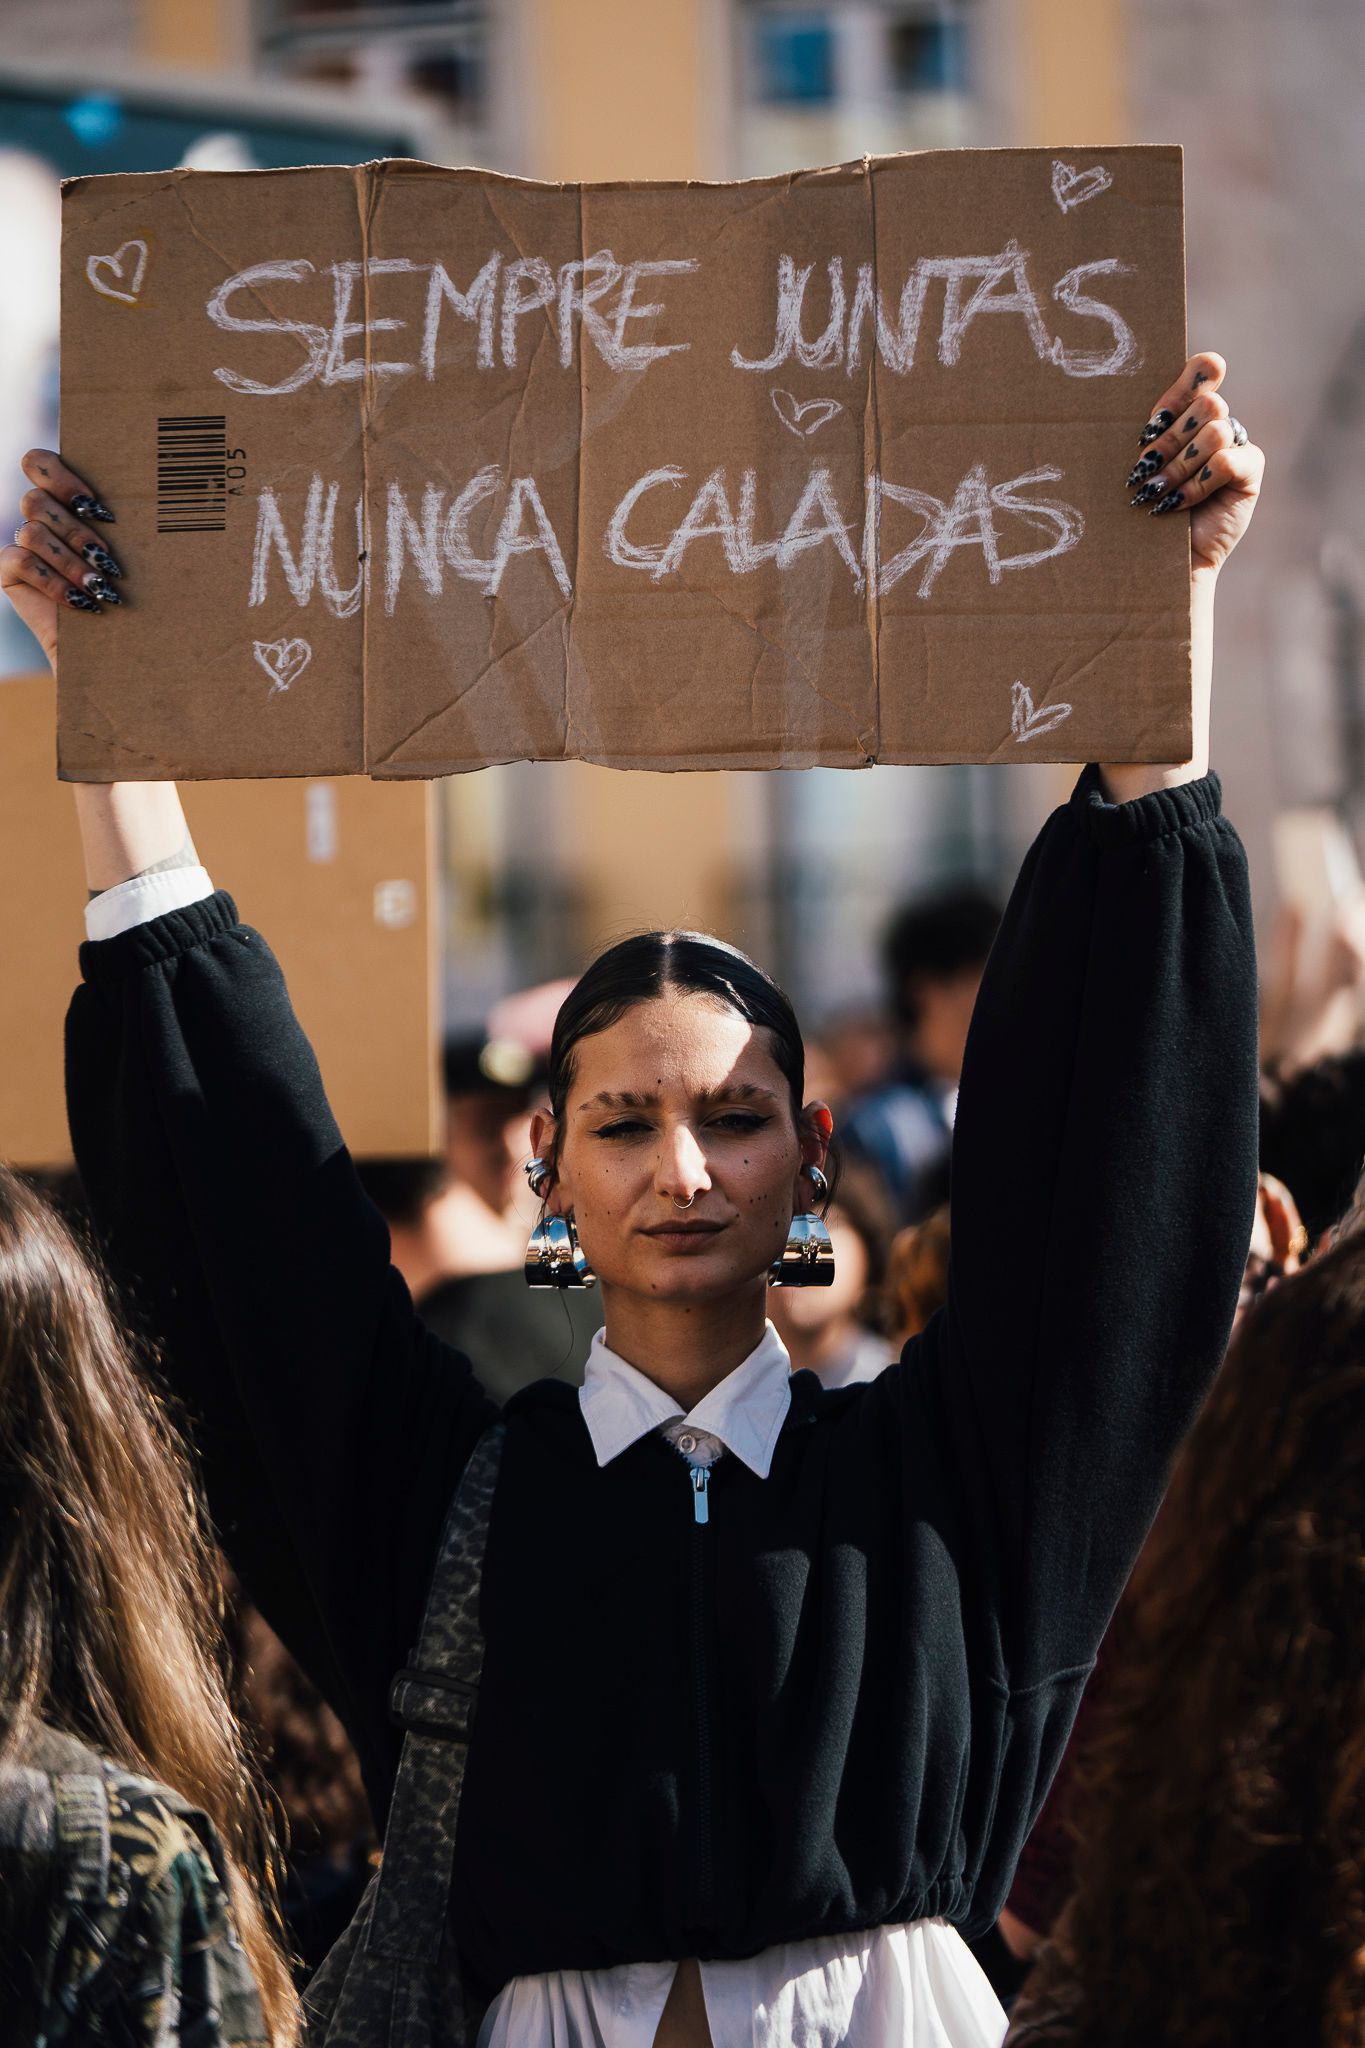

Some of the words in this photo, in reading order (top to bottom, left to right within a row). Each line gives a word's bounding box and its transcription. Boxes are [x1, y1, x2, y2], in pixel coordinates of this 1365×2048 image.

[206, 248, 699, 395] SEMPRE
[730, 238, 1146, 378] JUNTAS
[248, 464, 573, 619] NUNCA
[604, 457, 1086, 600] CALADAS
